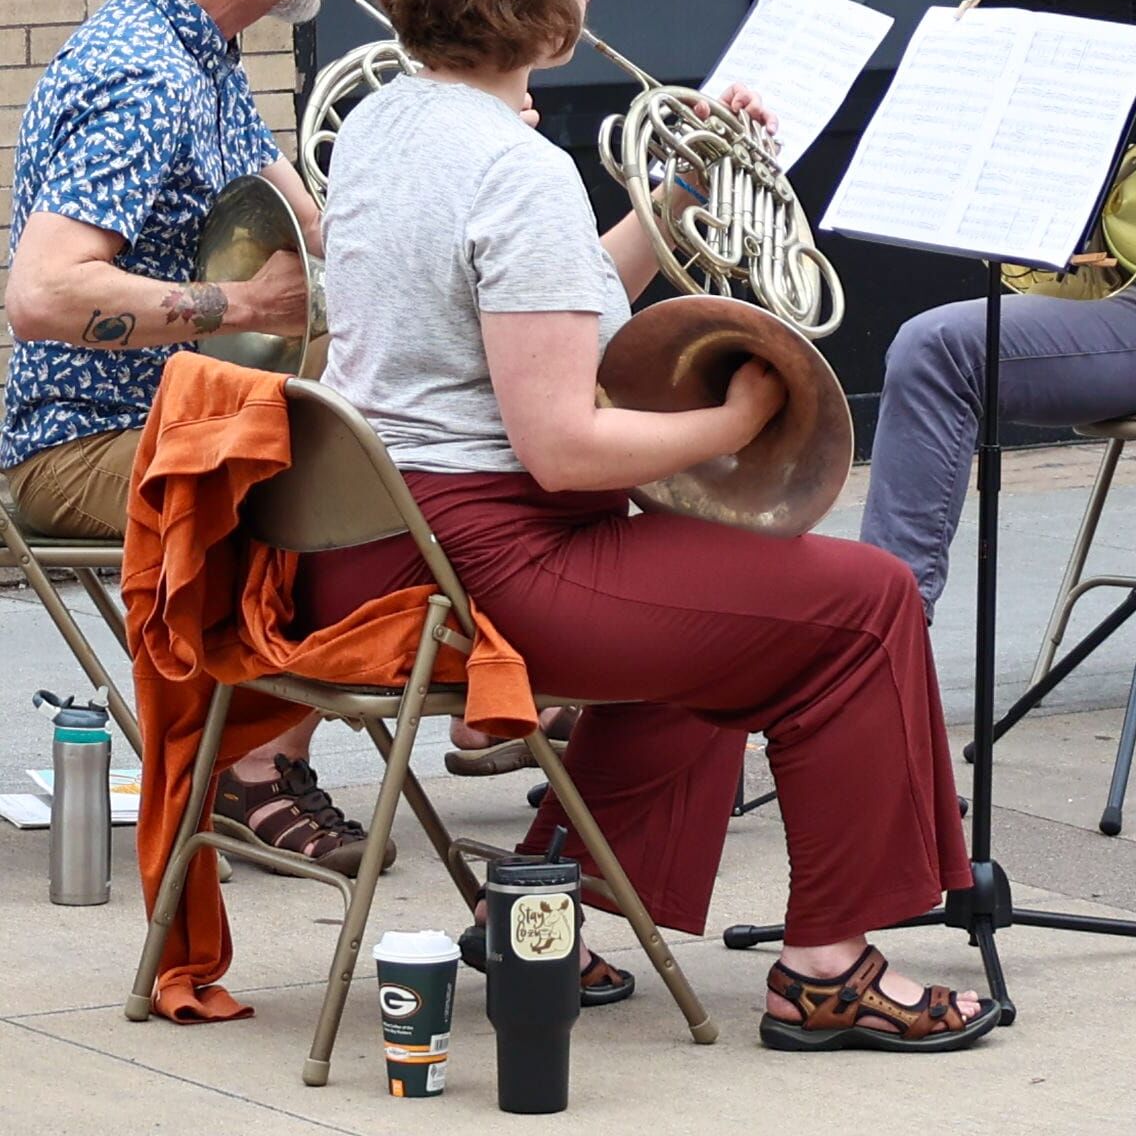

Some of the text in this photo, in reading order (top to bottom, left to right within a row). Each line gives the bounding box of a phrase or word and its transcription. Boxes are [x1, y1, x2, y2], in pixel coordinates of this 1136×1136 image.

[517, 903, 545, 929] Stay
[516, 921, 542, 946] Cozy
[379, 985, 419, 1017] G
